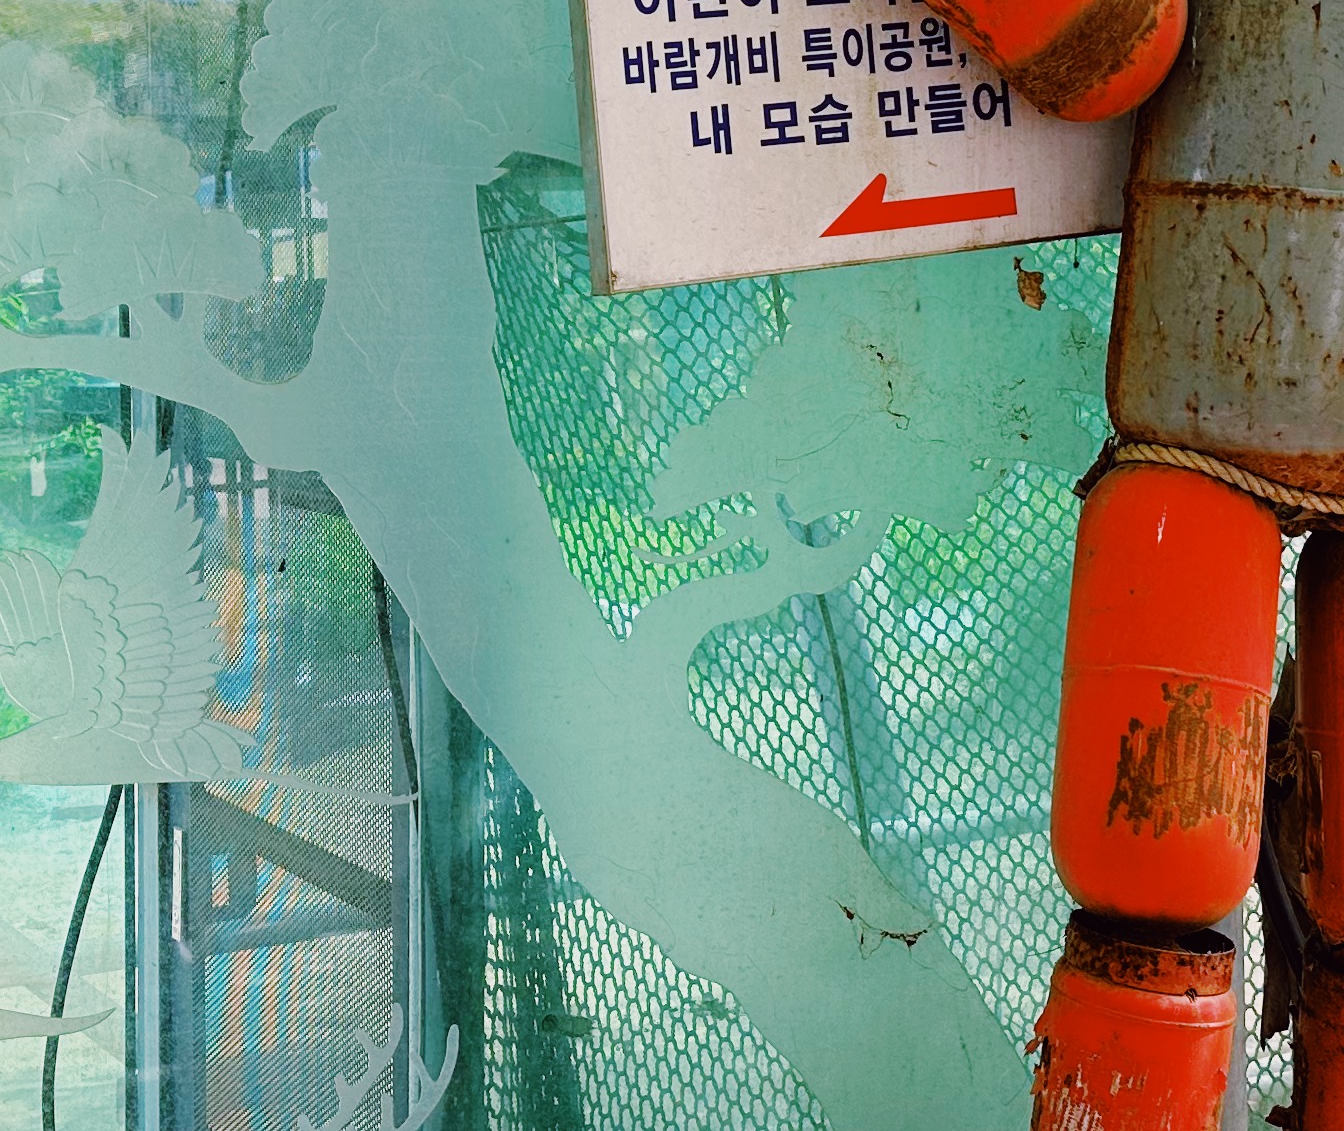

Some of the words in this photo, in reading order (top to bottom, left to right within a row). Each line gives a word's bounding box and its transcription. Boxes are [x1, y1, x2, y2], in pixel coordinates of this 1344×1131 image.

[622, 29, 782, 94] 바람개비
[801, 16, 967, 77] 특이공원,
[690, 103, 734, 156] 내
[760, 93, 853, 148] 모습
[877, 77, 1012, 138] 만들어
